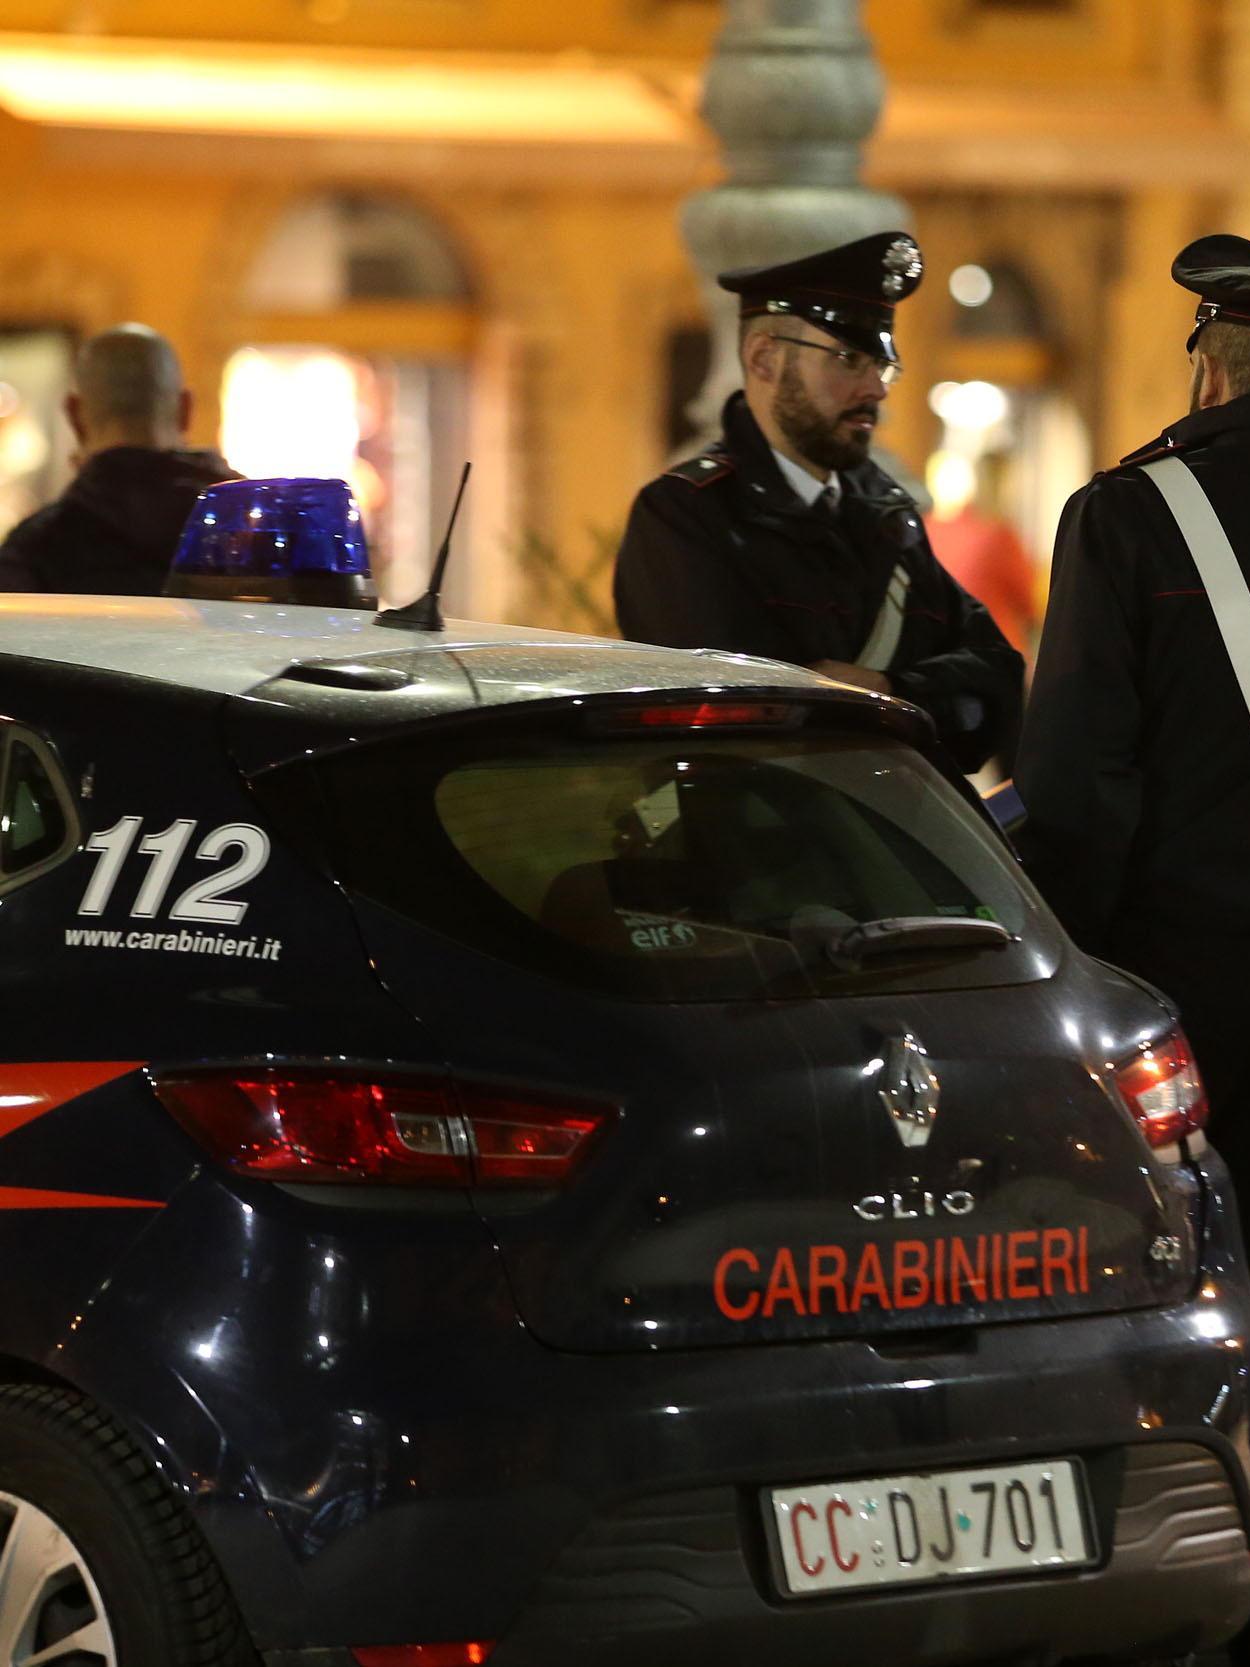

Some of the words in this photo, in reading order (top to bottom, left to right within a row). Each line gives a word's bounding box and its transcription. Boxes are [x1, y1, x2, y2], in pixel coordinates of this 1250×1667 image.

[77, 815, 272, 925] 112
[64, 929, 283, 961] www.carabinieri.it
[630, 925, 673, 949] elf
[852, 1190, 975, 1220] CLIO
[713, 1226, 1090, 1322] CARABINIERI
[789, 1497, 860, 1577] CC
[970, 1476, 1064, 1559] 701
